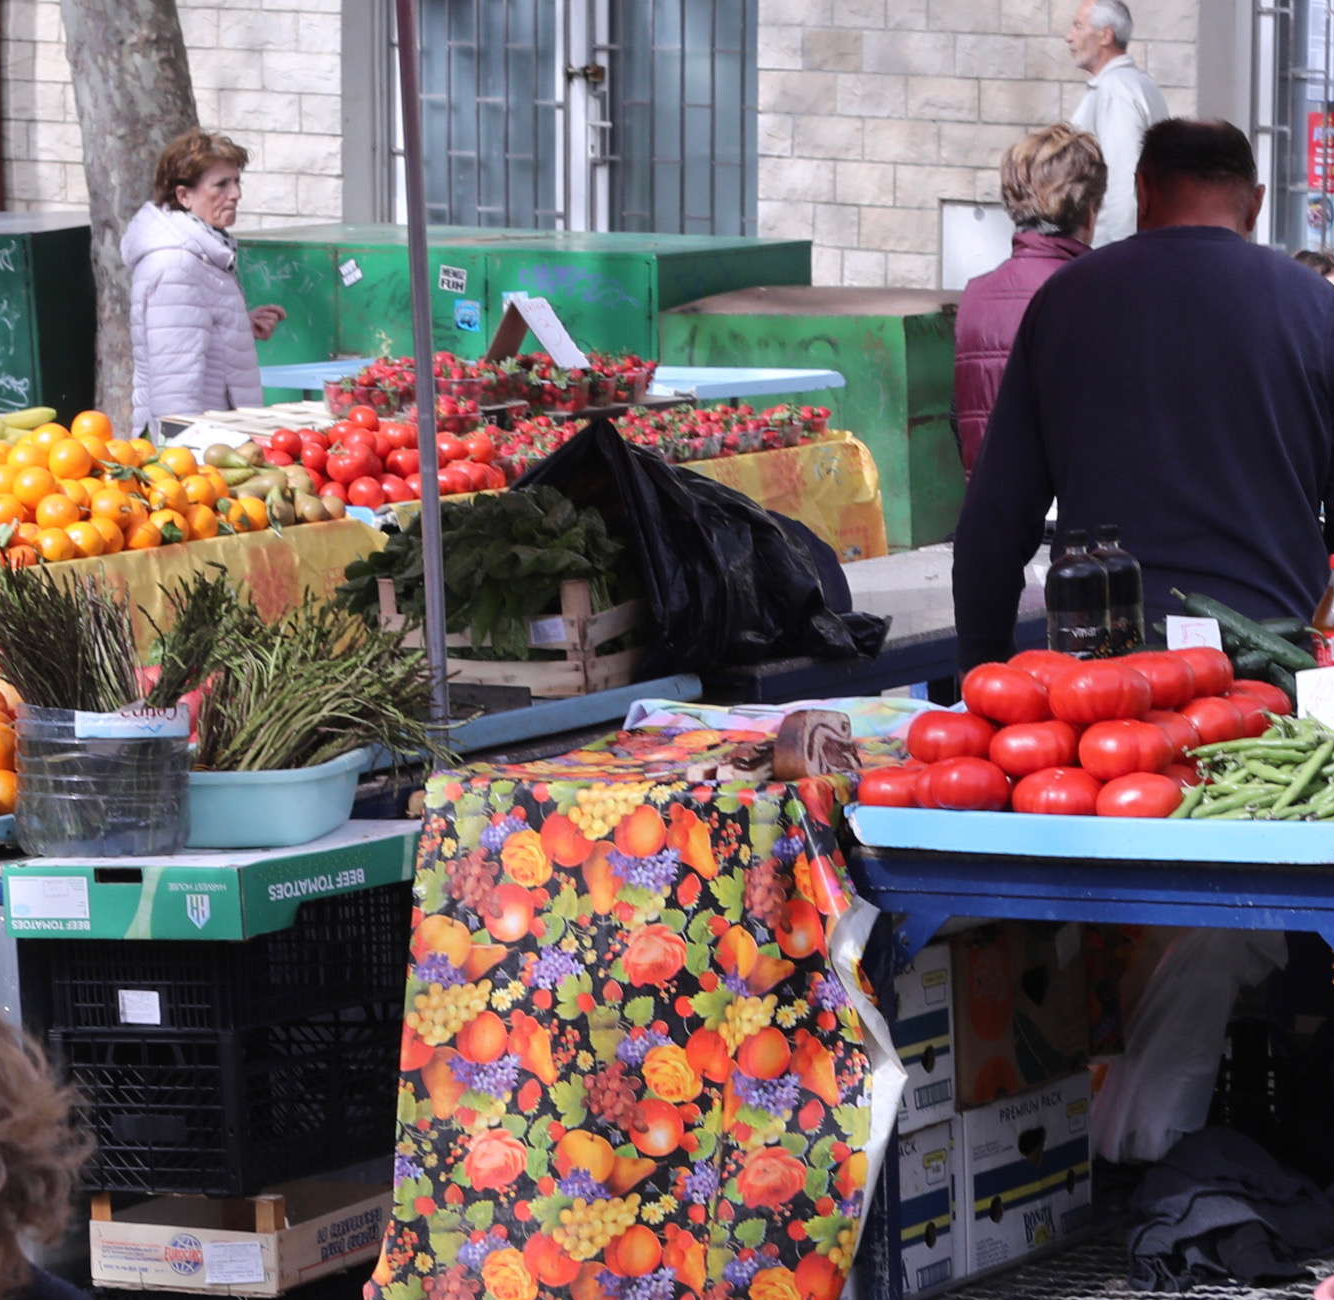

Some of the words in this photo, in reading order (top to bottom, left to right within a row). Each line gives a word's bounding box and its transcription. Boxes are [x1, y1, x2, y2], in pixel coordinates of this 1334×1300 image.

[336, 868, 366, 889] BEEF
[268, 875, 335, 901] TOMATOES
[11, 919, 64, 931] TOMATOES
[66, 919, 91, 931] BEEF
